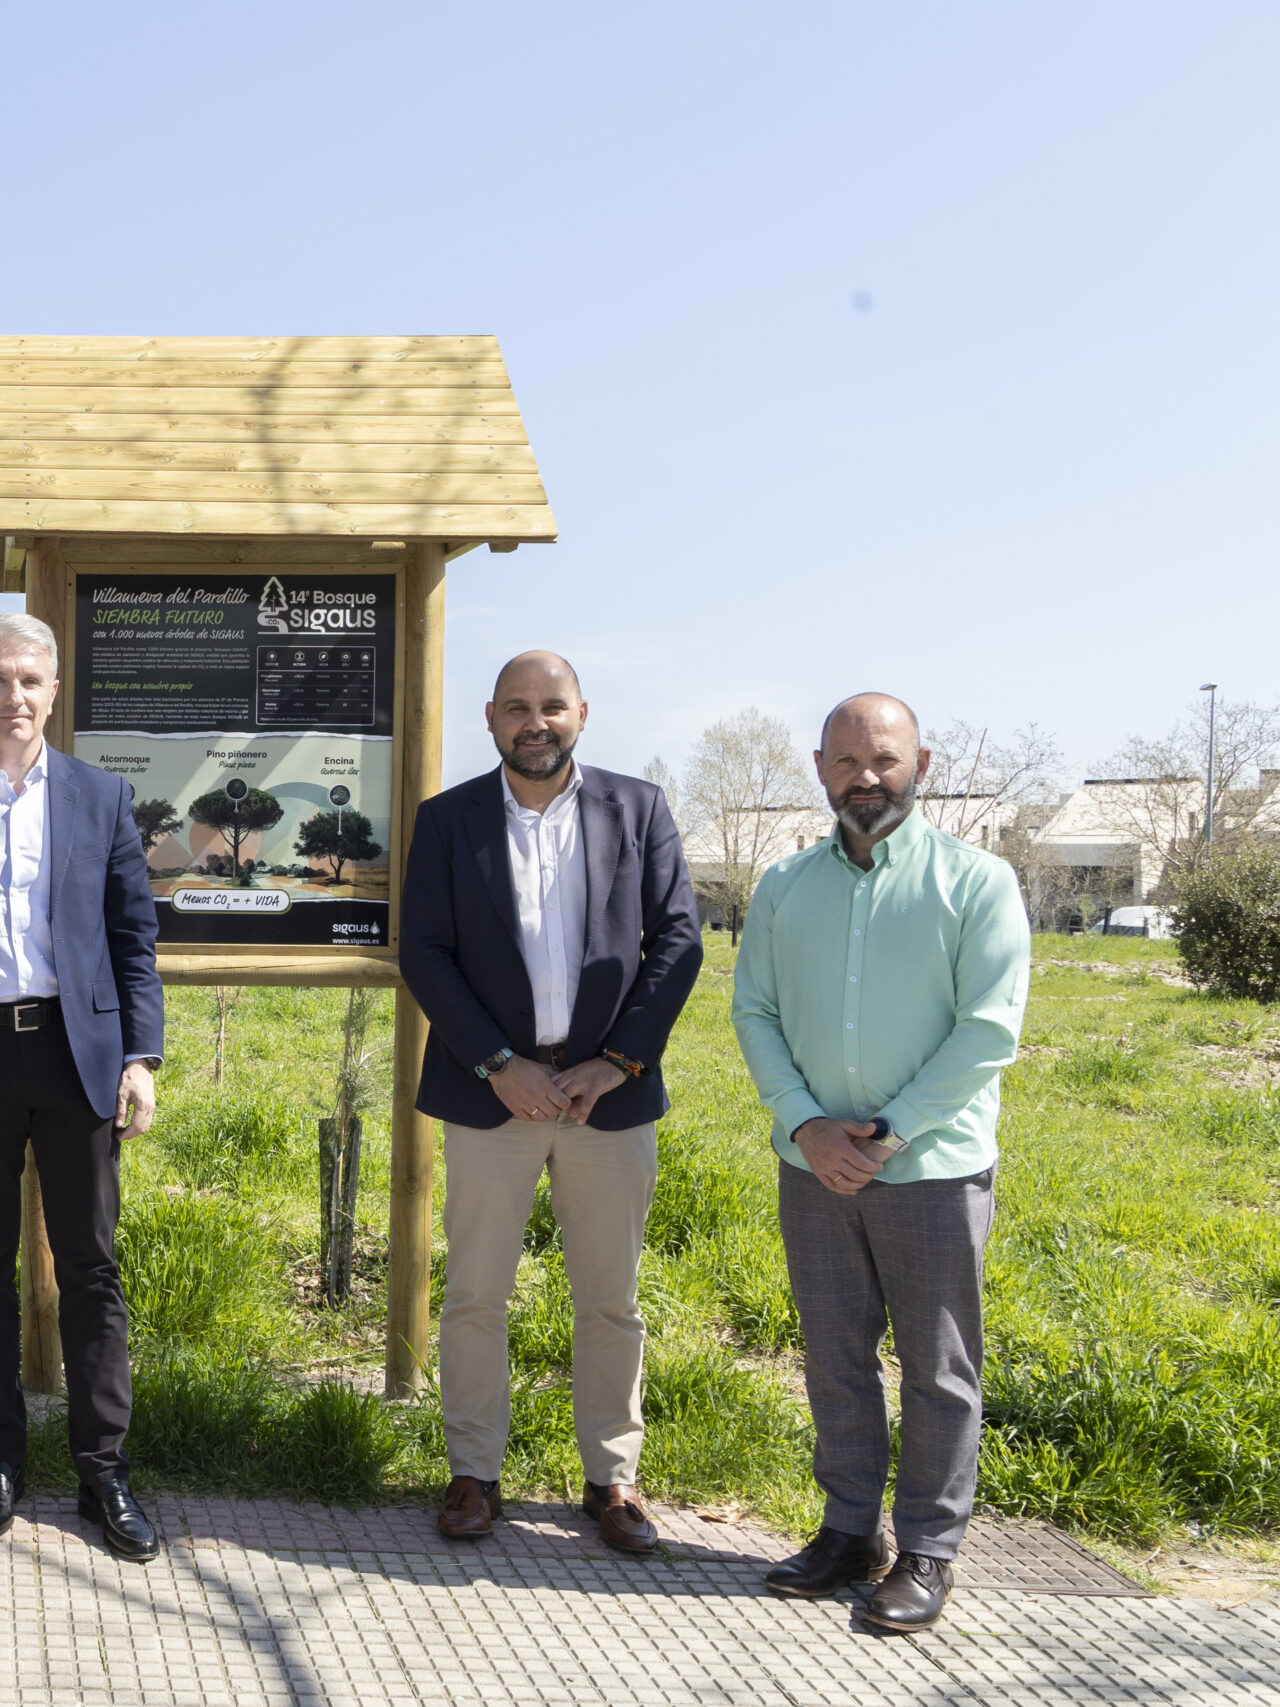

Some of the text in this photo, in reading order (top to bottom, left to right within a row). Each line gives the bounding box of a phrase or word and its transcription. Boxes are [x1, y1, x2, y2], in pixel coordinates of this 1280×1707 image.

[92, 586, 251, 605] Villanueva del Pardillo
[313, 590, 377, 608] Bosque
[92, 608, 224, 625] SIEMBRA FUTURO
[289, 608, 376, 633] sigaus
[92, 628, 245, 640] con 1.000 nuevos árboles de SIGAUS
[92, 680, 194, 693] Un bosque con nombre propio
[99, 755, 151, 765] Alcornoque
[206, 750, 268, 760] Pino piñonero
[324, 756, 355, 765] Encina
[181, 893, 212, 905] Menos
[255, 895, 280, 907] VIDA
[332, 923, 369, 935] sigaus
[332, 937, 380, 946] www.sigaus.es
